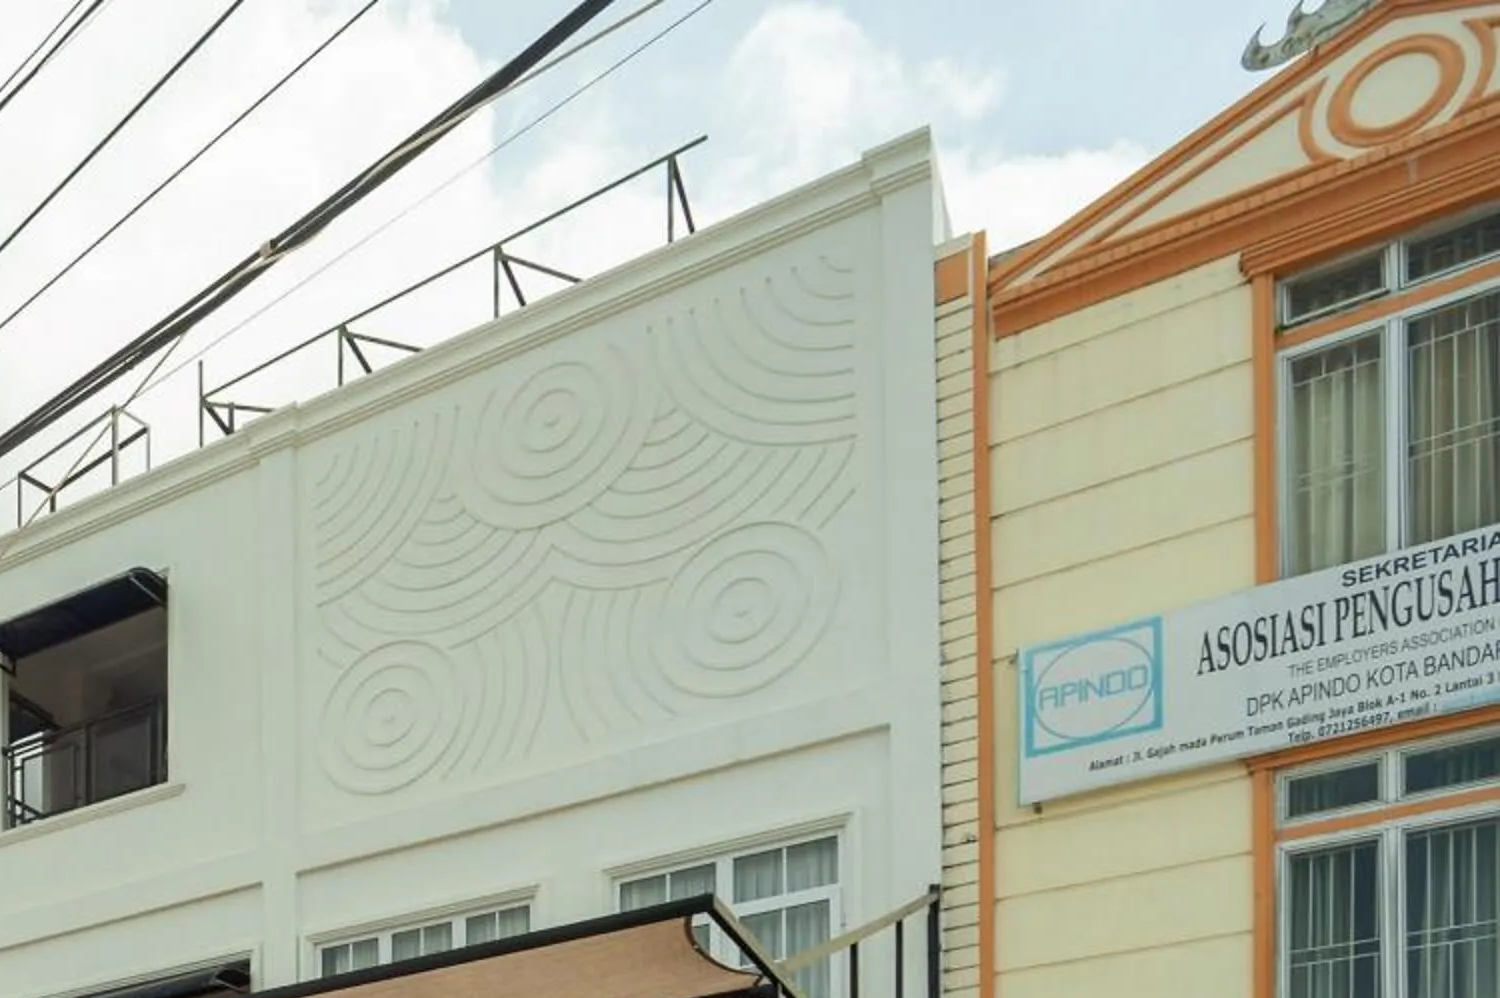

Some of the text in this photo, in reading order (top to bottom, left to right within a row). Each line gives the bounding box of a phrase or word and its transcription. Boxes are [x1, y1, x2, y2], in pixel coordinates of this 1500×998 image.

[1197, 601, 1327, 676] ASOSIASI
[1288, 616, 1496, 678] THE EMPLOYERS ASSOCIATION
[1038, 664, 1149, 711] APINDO
[1246, 690, 1284, 717] DPK
[1287, 673, 1361, 708] APINDO
[1366, 660, 1420, 690] KOTA
[1088, 755, 1124, 772] Alamat
[1146, 744, 1176, 760] Gajah
[1179, 737, 1208, 750] mada
[1210, 730, 1245, 745] Perum
[1248, 721, 1284, 736] Taman
[1286, 711, 1326, 729] Gading
[1328, 705, 1354, 719] Jaya
[1357, 699, 1383, 713] Blok
[1386, 692, 1405, 706] A-1
[1410, 688, 1431, 700] No.
[1445, 676, 1483, 693] Lantai
